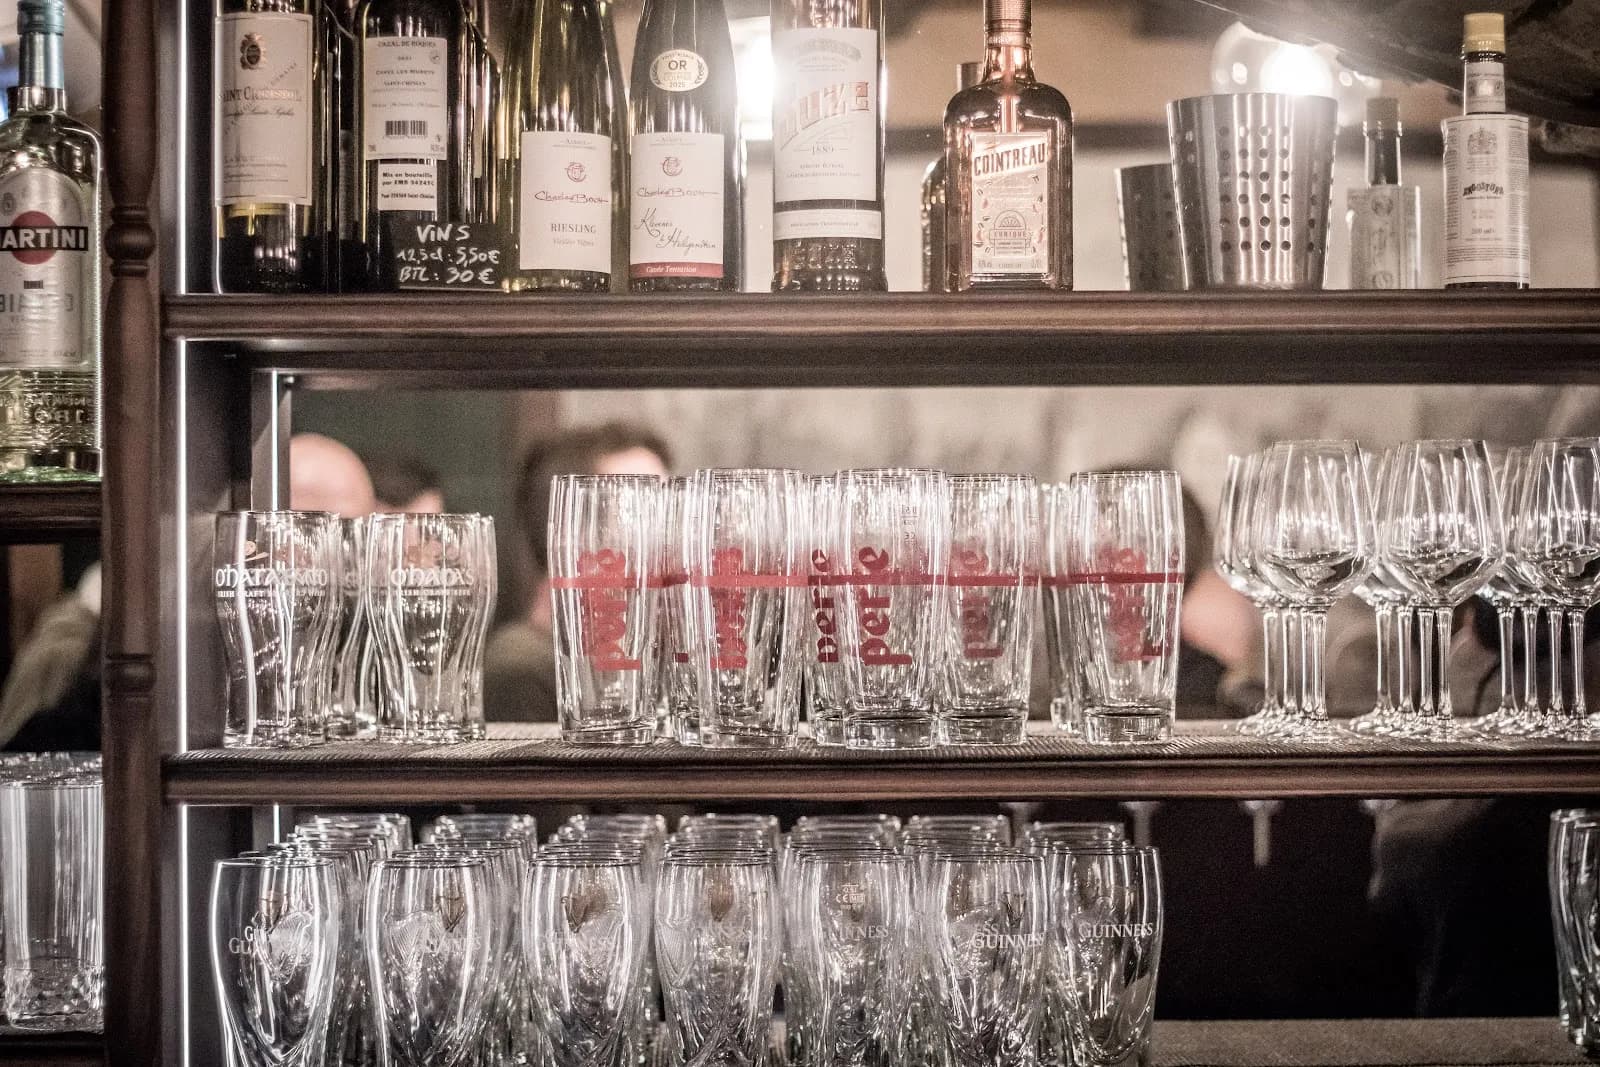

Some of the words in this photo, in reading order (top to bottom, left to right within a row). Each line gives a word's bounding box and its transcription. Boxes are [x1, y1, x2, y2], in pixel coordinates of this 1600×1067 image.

[668, 60, 687, 71] OR
[973, 143, 1047, 176] COINTREAU
[550, 223, 597, 234] RIESLING
[0, 227, 86, 249] ARTINI
[1078, 922, 1154, 939] GUINNESS
